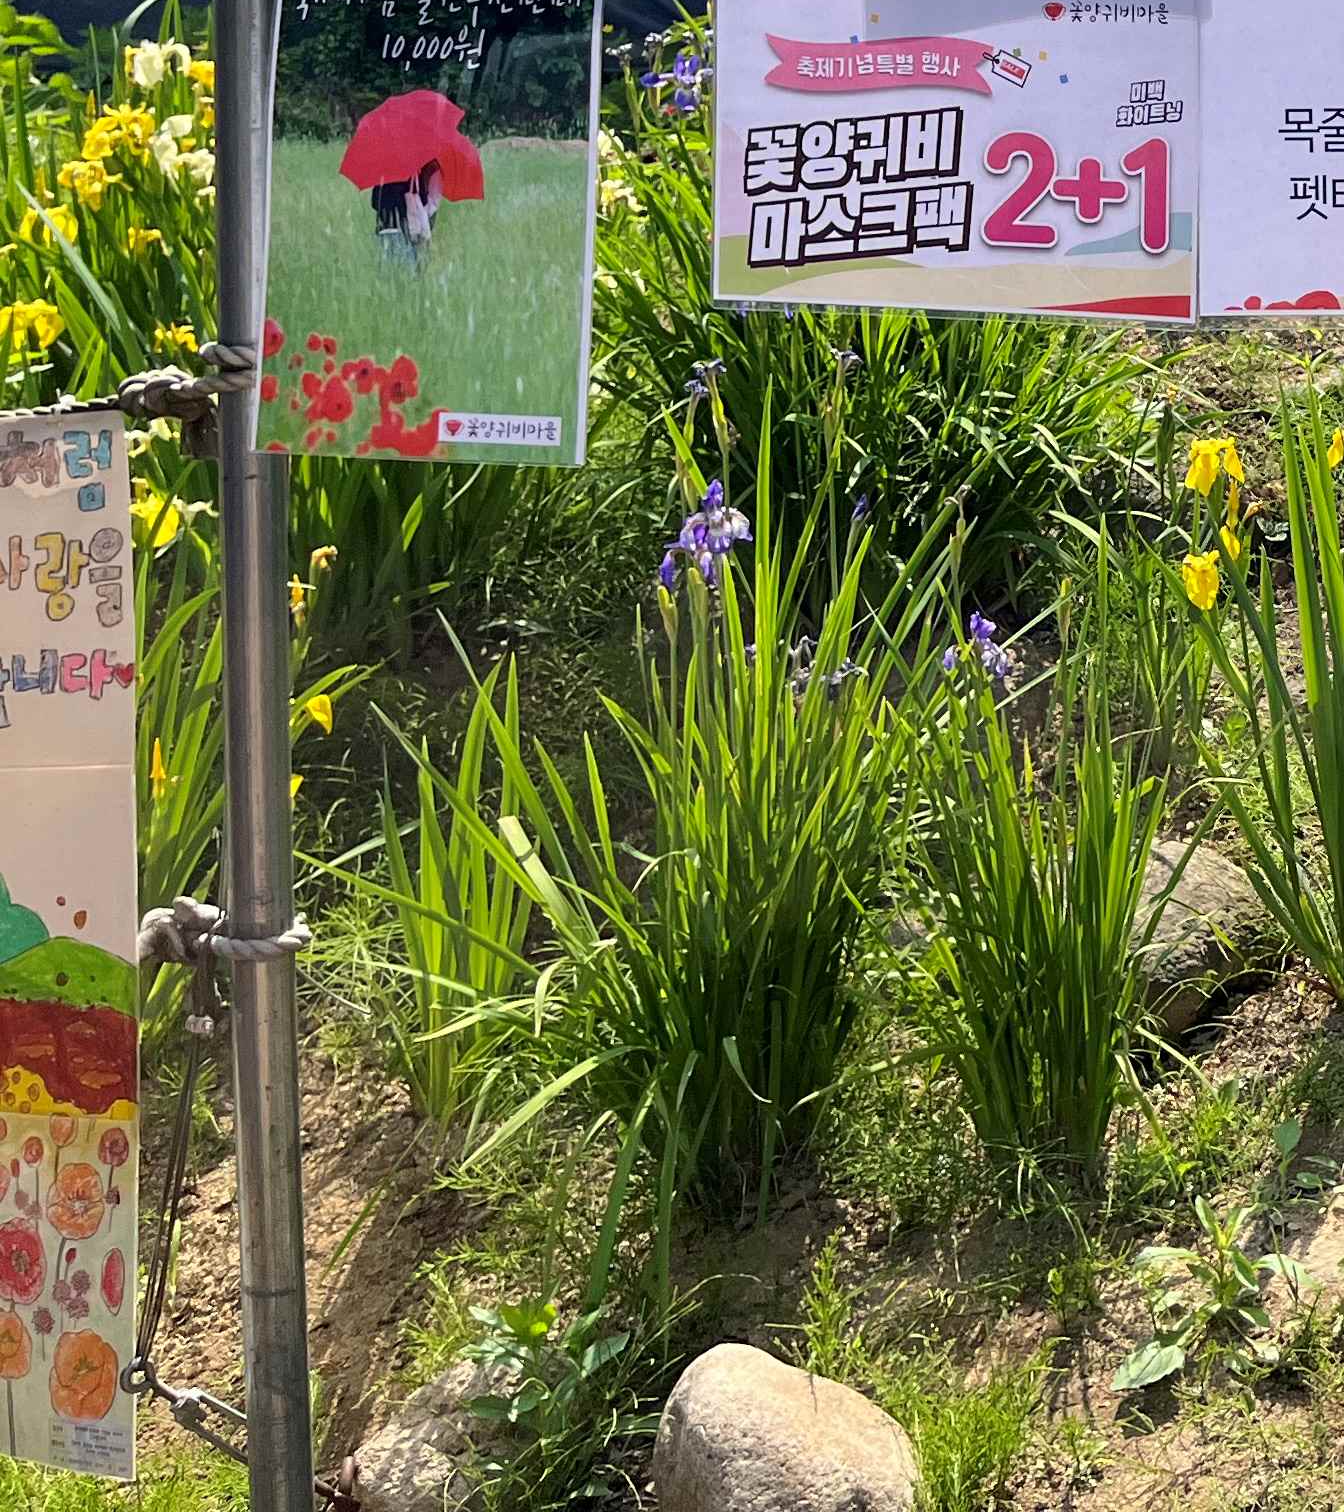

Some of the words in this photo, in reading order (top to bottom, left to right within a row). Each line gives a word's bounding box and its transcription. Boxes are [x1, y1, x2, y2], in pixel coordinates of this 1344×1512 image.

[1069, 1, 1169, 25] 꽃양귀비마을
[381, 25, 486, 71] 10,000원
[796, 52, 914, 79] 축제기념특별
[921, 51, 961, 79] 행사
[1130, 80, 1165, 103] 미백
[1116, 100, 1183, 127] 화이트닝
[744, 106, 964, 196] 꽃양귀비
[980, 130, 1171, 256] 2+1
[747, 183, 975, 268] 마스크팩
[466, 418, 557, 441] 꽃양귀비마을
[0, 648, 114, 726] 니다
